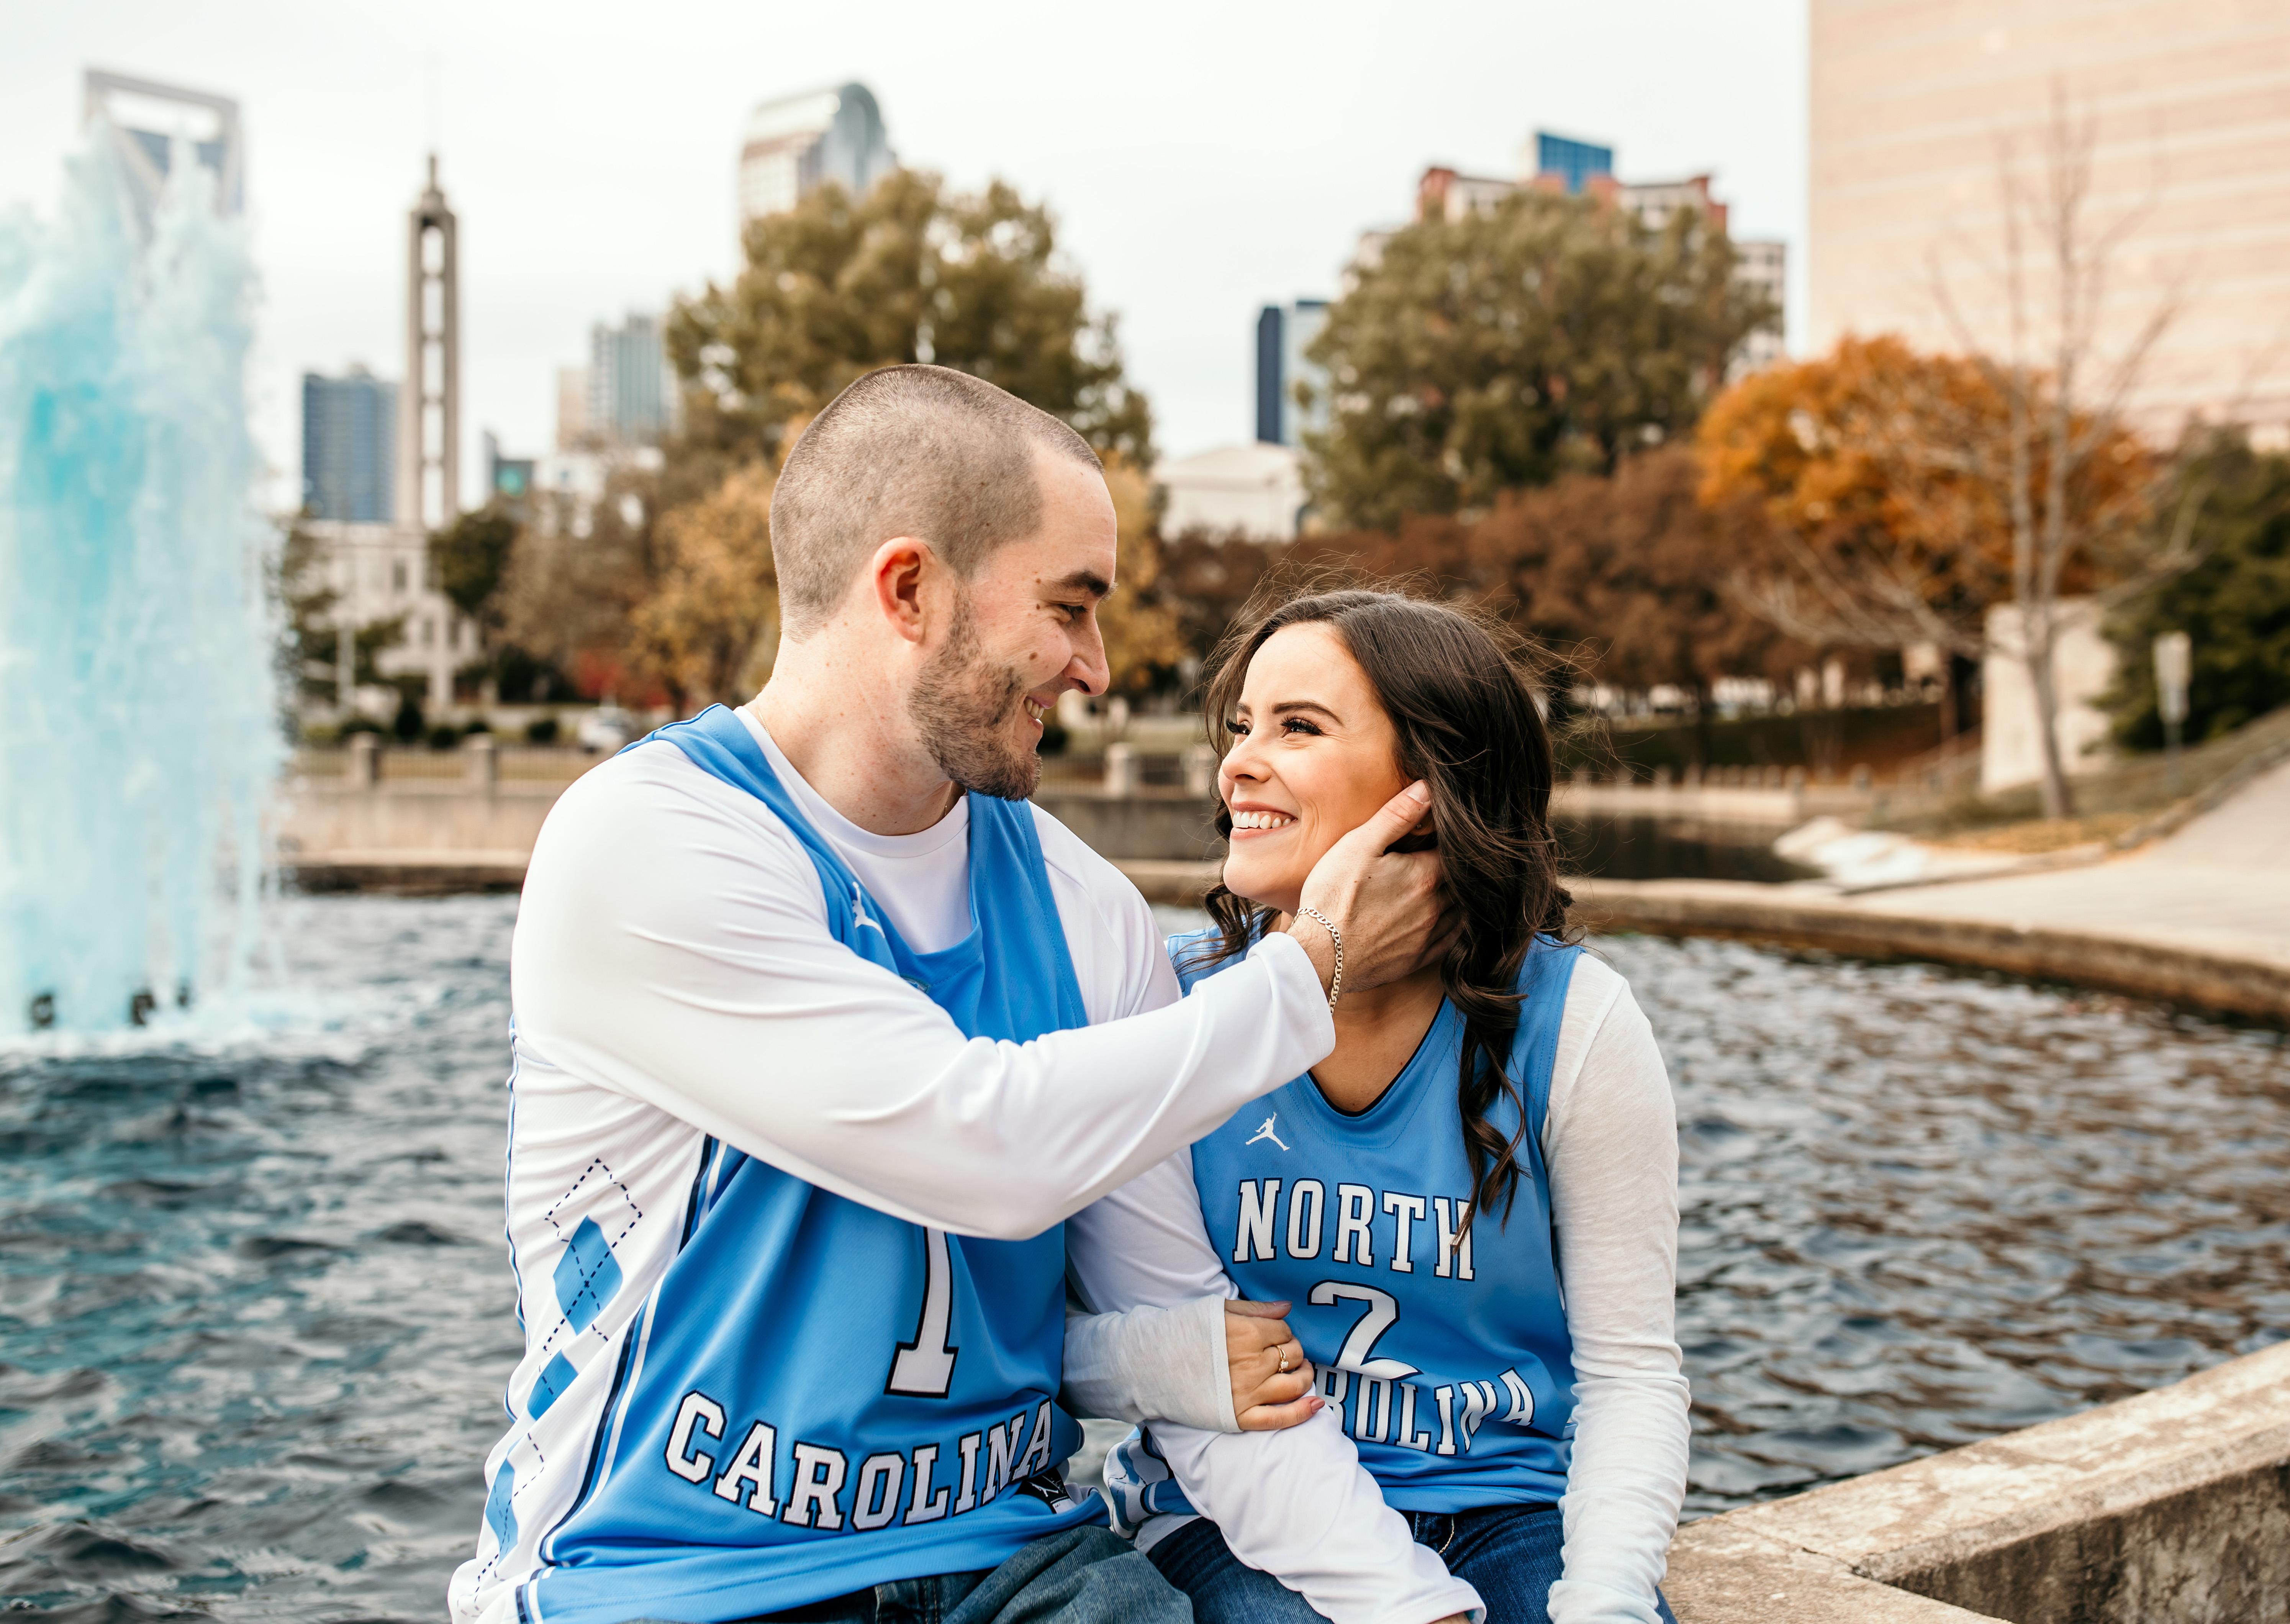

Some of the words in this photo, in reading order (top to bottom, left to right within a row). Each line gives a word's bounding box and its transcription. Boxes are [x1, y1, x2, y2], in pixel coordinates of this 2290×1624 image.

[1232, 1178, 1476, 1281] NORTH
[884, 1227, 959, 1399] 1
[1307, 1280, 1424, 1380] 2
[666, 1391, 1053, 1530] CAROLINA
[1310, 1364, 1535, 1455] ROLINA
